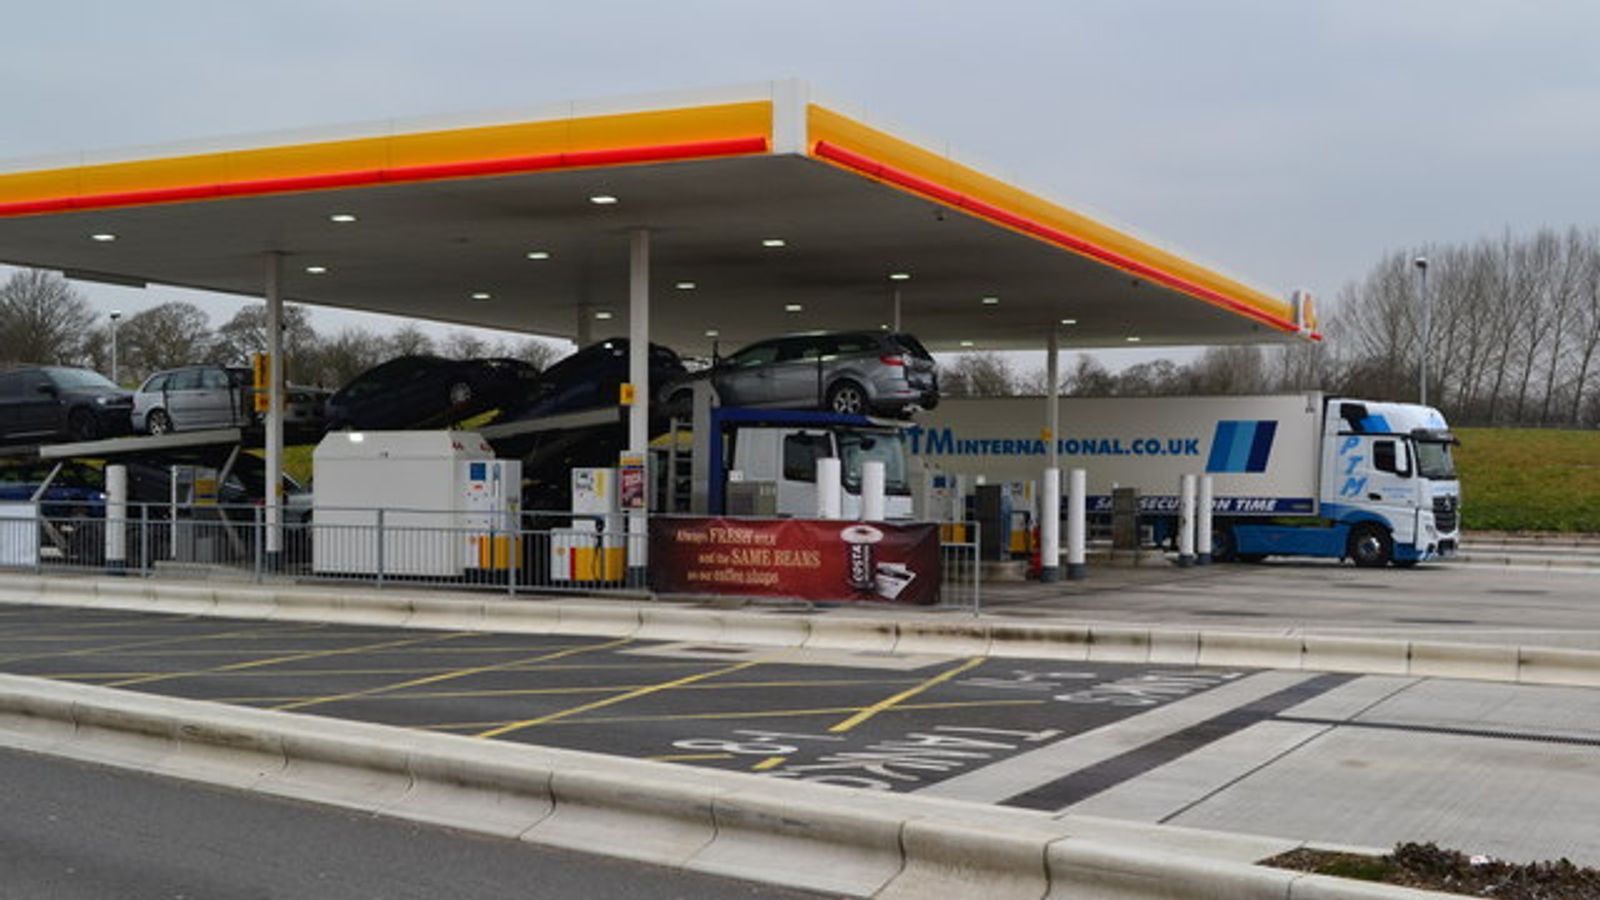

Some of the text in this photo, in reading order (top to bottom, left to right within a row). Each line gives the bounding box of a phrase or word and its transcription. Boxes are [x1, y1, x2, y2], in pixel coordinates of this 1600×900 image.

[1235, 499, 1278, 512] TIME
[709, 527, 753, 544] FRESH
[731, 547, 772, 567] SAME
[773, 548, 822, 569] BEANS
[851, 544, 864, 582] COSTA
